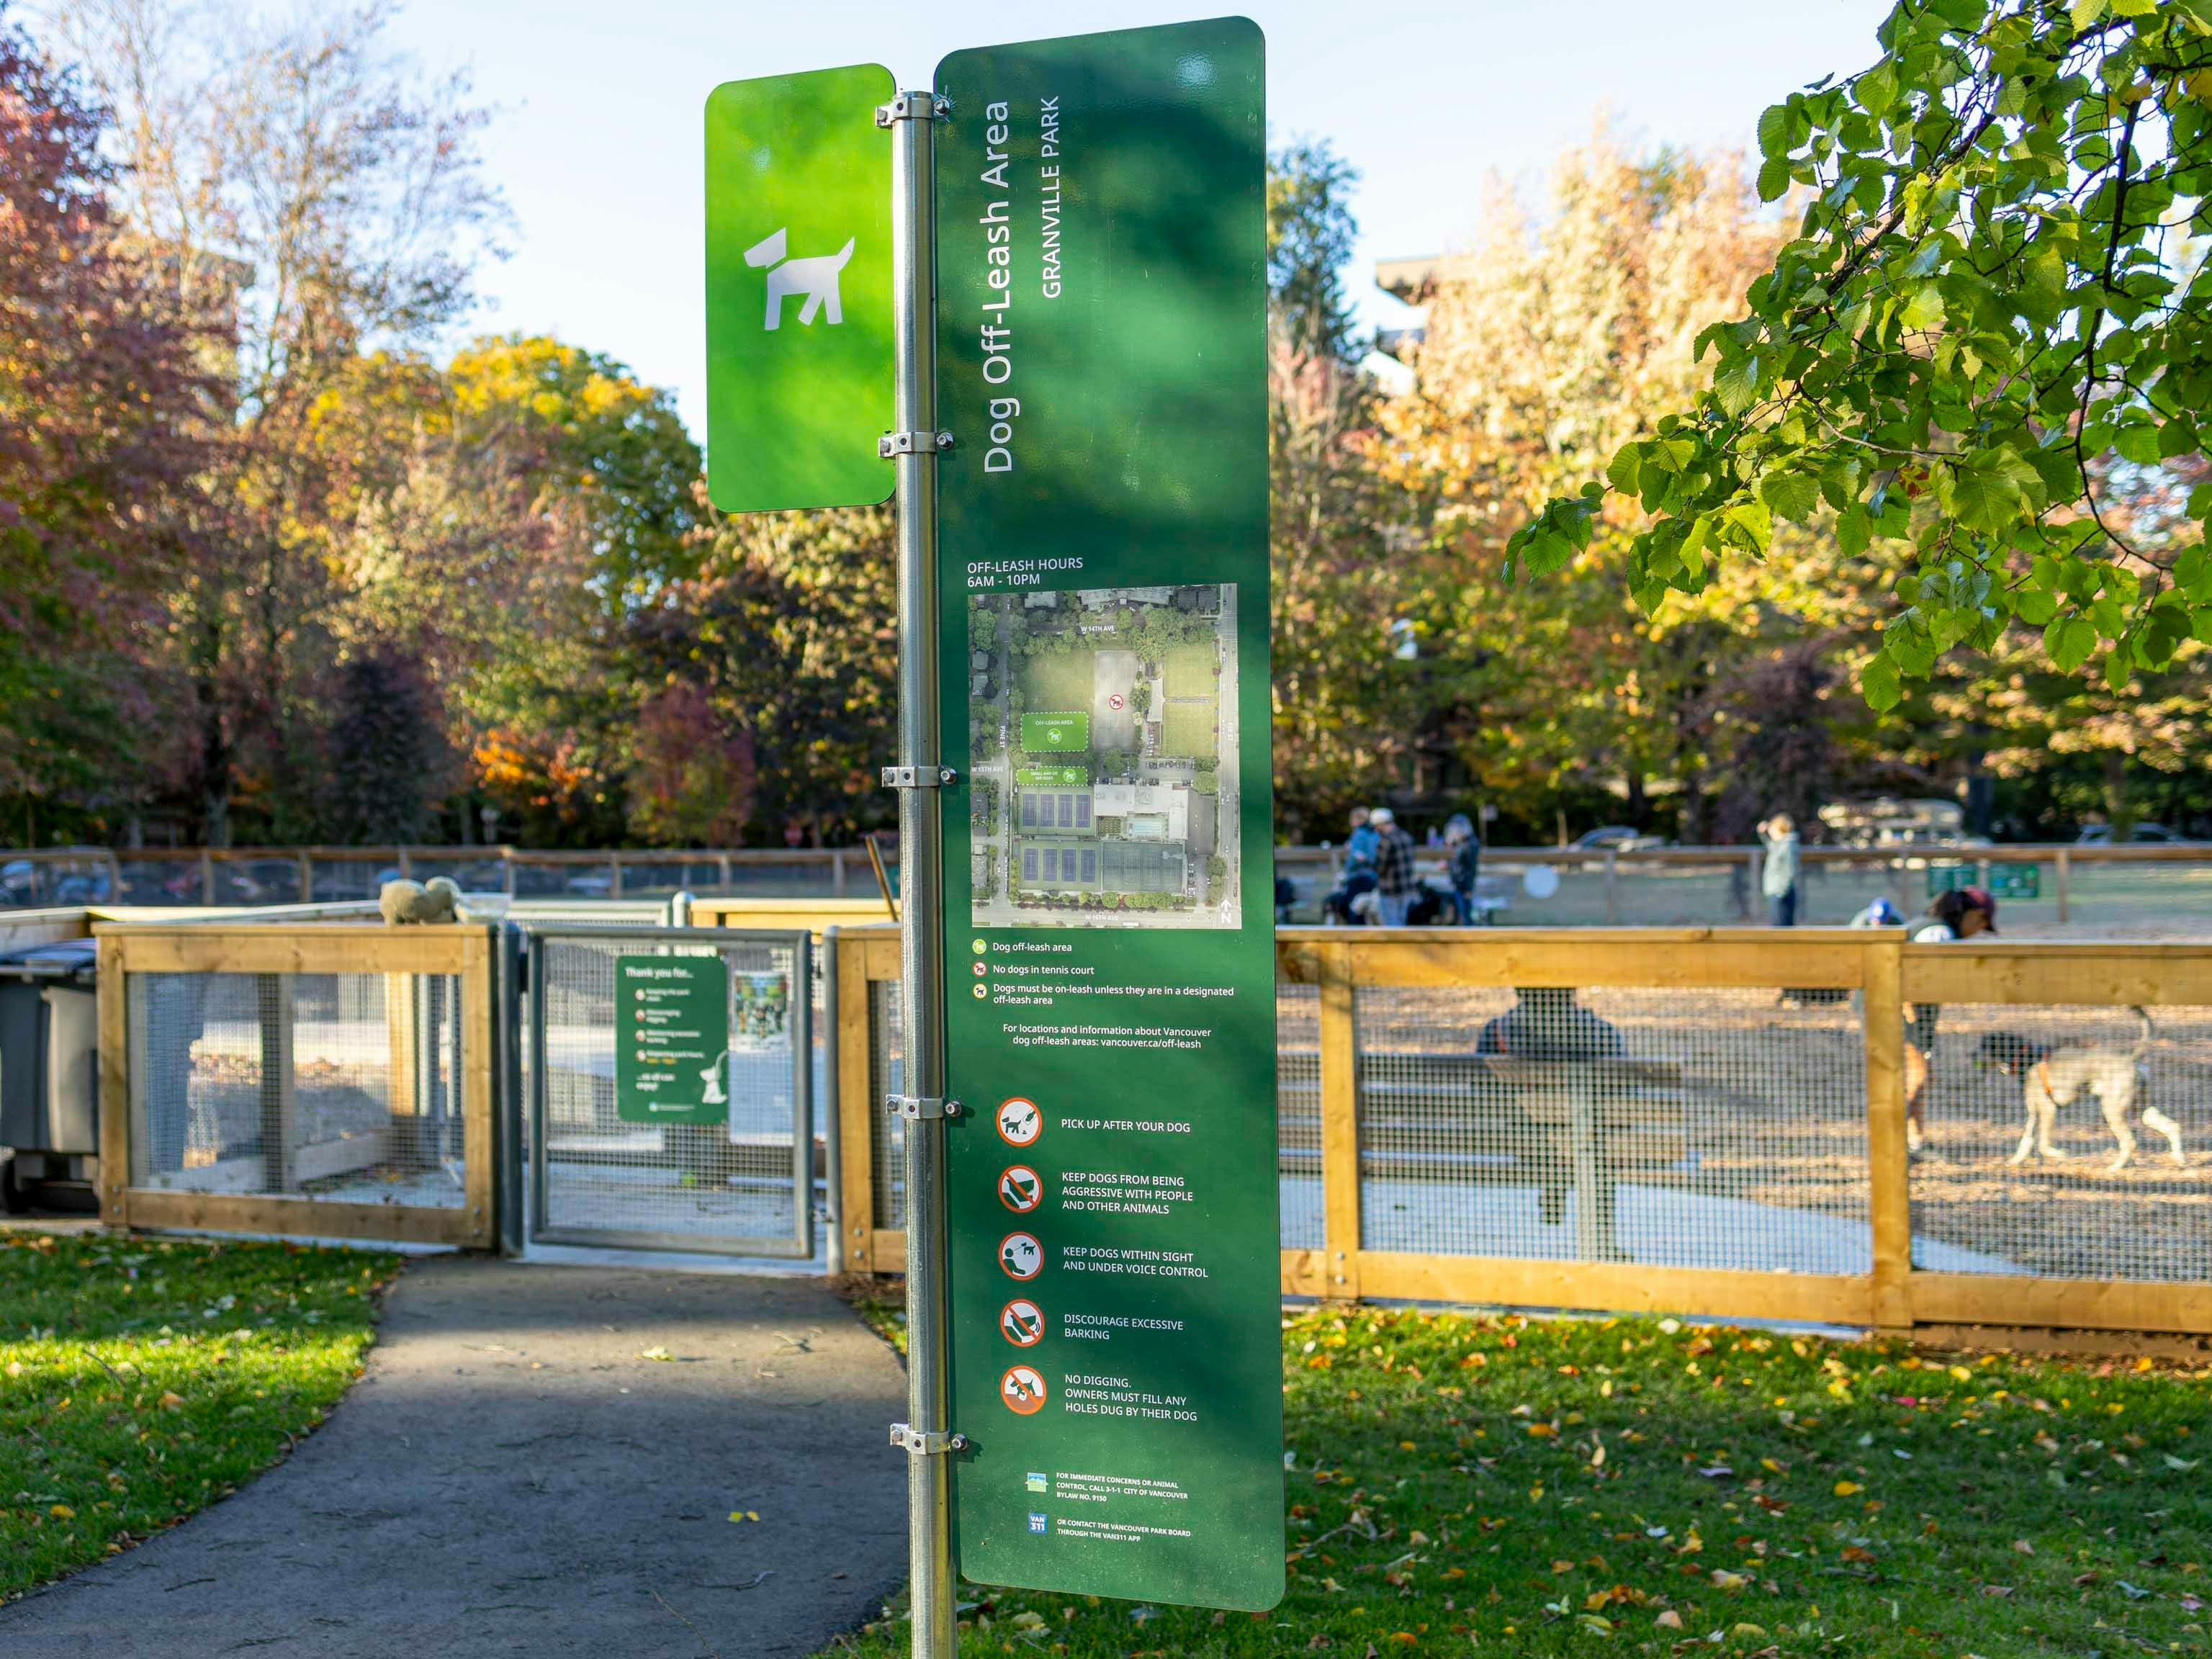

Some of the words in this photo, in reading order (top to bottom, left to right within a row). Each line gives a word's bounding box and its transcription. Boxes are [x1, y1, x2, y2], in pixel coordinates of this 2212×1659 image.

[1040, 95, 1060, 158] PARK
[980, 101, 1009, 189] Area
[1041, 165, 1062, 300] GRANVILLE
[980, 201, 1011, 385] Off-Leash
[984, 397, 1020, 474] Dog
[967, 559, 1033, 573] OFF-LEASH
[1038, 557, 1082, 570] HOURS
[967, 575, 994, 587] 6AM
[1007, 573, 1039, 585] 10PM
[1220, 912, 1232, 924] N
[993, 942, 1010, 953] Dog
[1012, 942, 1050, 951] off-leash
[625, 966, 653, 978] Thank
[655, 968, 671, 979] you
[1007, 965, 1029, 976] dogs
[1030, 965, 1039, 974] in
[993, 984, 1015, 996] Dogs
[1042, 984, 1053, 992] be
[1055, 984, 1092, 993] on-leash
[1094, 985, 1123, 994] unless
[1125, 985, 1145, 997] they
[1164, 986, 1172, 994] in
[1182, 986, 1233, 997] designated
[993, 994, 1030, 1004] off-leash
[1019, 1024, 1058, 1033] locations
[1061, 1025, 1077, 1033] and
[1079, 1025, 1132, 1035] information
[1134, 1026, 1161, 1035] about
[1163, 1028, 1211, 1036] Vancouver
[1012, 1035, 1030, 1046] dog
[1032, 1035, 1069, 1045] off-leash
[1100, 1038, 1201, 1048] vancouver.ca/off-leash
[1061, 1118, 1084, 1128] PICK
[1087, 1120, 1100, 1129] UP
[1102, 1120, 1133, 1130] AFTER
[1136, 1121, 1164, 1131] YOUR
[1166, 1123, 1190, 1132] DOG
[1062, 1172, 1086, 1182] KEEP
[1089, 1173, 1117, 1183] DOGS
[1120, 1174, 1148, 1184] FROM
[1152, 1176, 1184, 1186] BEING
[1062, 1186, 1122, 1197] AGGRESSIVE
[1125, 1189, 1151, 1198] WITH
[1155, 1190, 1192, 1201] PEOPLE
[1062, 1200, 1084, 1210] AND
[1087, 1201, 1120, 1211] OTHER
[1123, 1203, 1169, 1214] ANIMALS
[1064, 1246, 1087, 1256] KEEP
[1090, 1248, 1118, 1258] DOGS
[1120, 1249, 1159, 1260] WITHIN
[1162, 1251, 1194, 1262] SIGHT
[1063, 1261, 1085, 1270] AND
[1088, 1262, 1123, 1272] UNDER
[1125, 1264, 1156, 1274] VOICE
[1159, 1266, 1208, 1277] CONTROL
[1064, 1313, 1128, 1326] DISCOURAGE
[1132, 1318, 1183, 1330] EXCESSIVE
[1064, 1328, 1109, 1339] BARKING
[1065, 1374, 1080, 1384] NO
[1084, 1375, 1130, 1388] DIGGING.
[1065, 1388, 1108, 1400] OWNERS
[1111, 1391, 1140, 1402] MUST
[1143, 1393, 1162, 1404] FILL
[1165, 1395, 1186, 1406] ANY
[1066, 1402, 1097, 1413] HOLES
[1100, 1405, 1123, 1415] DUG
[1125, 1406, 1138, 1416] BY
[1141, 1408, 1171, 1419] THEIR
[1174, 1410, 1197, 1421] DOG
[1070, 1473, 1105, 1482] IMMEDIATE
[1106, 1476, 1141, 1487] CONCERNS
[1056, 1482, 1087, 1491] CONTROL,
[1148, 1490, 1187, 1498] VANCOUVER
[1030, 1522, 1045, 1532] 311
[1057, 1528, 1088, 1537] THROUGH
[1110, 1524, 1148, 1532] VANCOUVER
